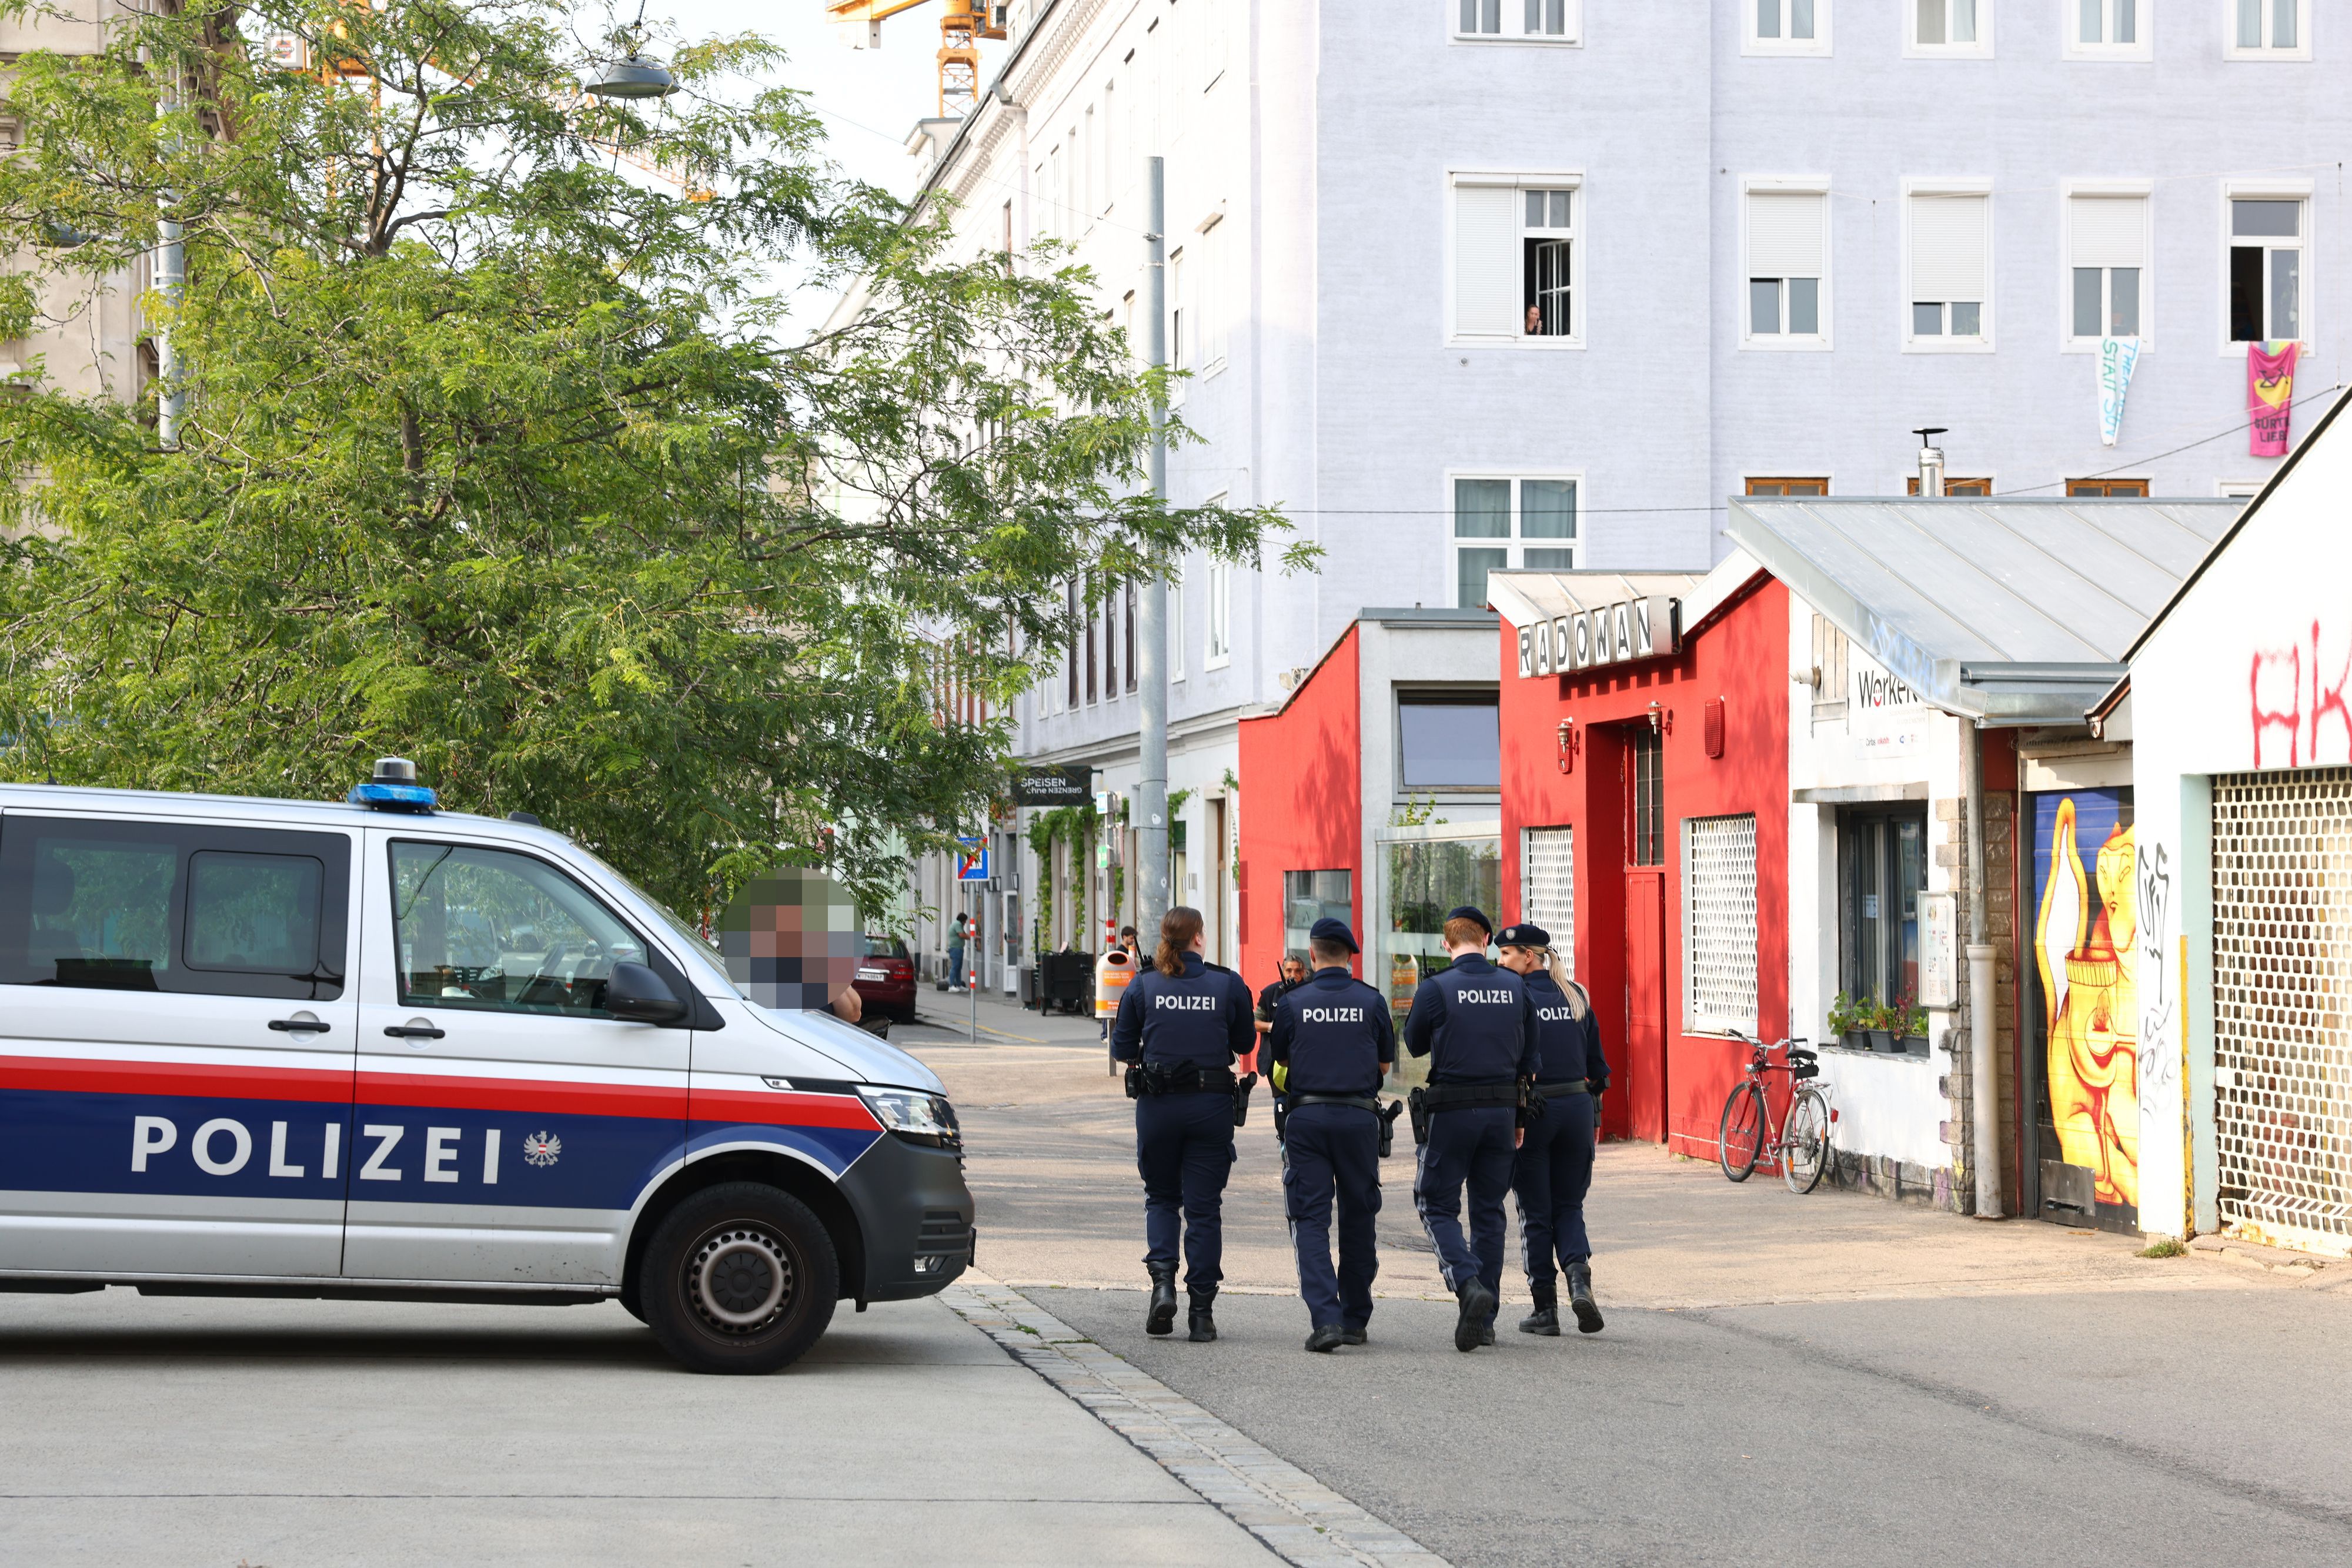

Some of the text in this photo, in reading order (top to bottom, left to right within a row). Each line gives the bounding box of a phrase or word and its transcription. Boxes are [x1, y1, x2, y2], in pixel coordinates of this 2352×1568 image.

[1520, 601, 1652, 671] RADOWAN
[1155, 995, 1216, 1011] POLIZEI
[1458, 989, 1514, 1004] POLIZEI
[1303, 1007, 1363, 1022] POLIZEI
[131, 1115, 501, 1184] POLIZEI
